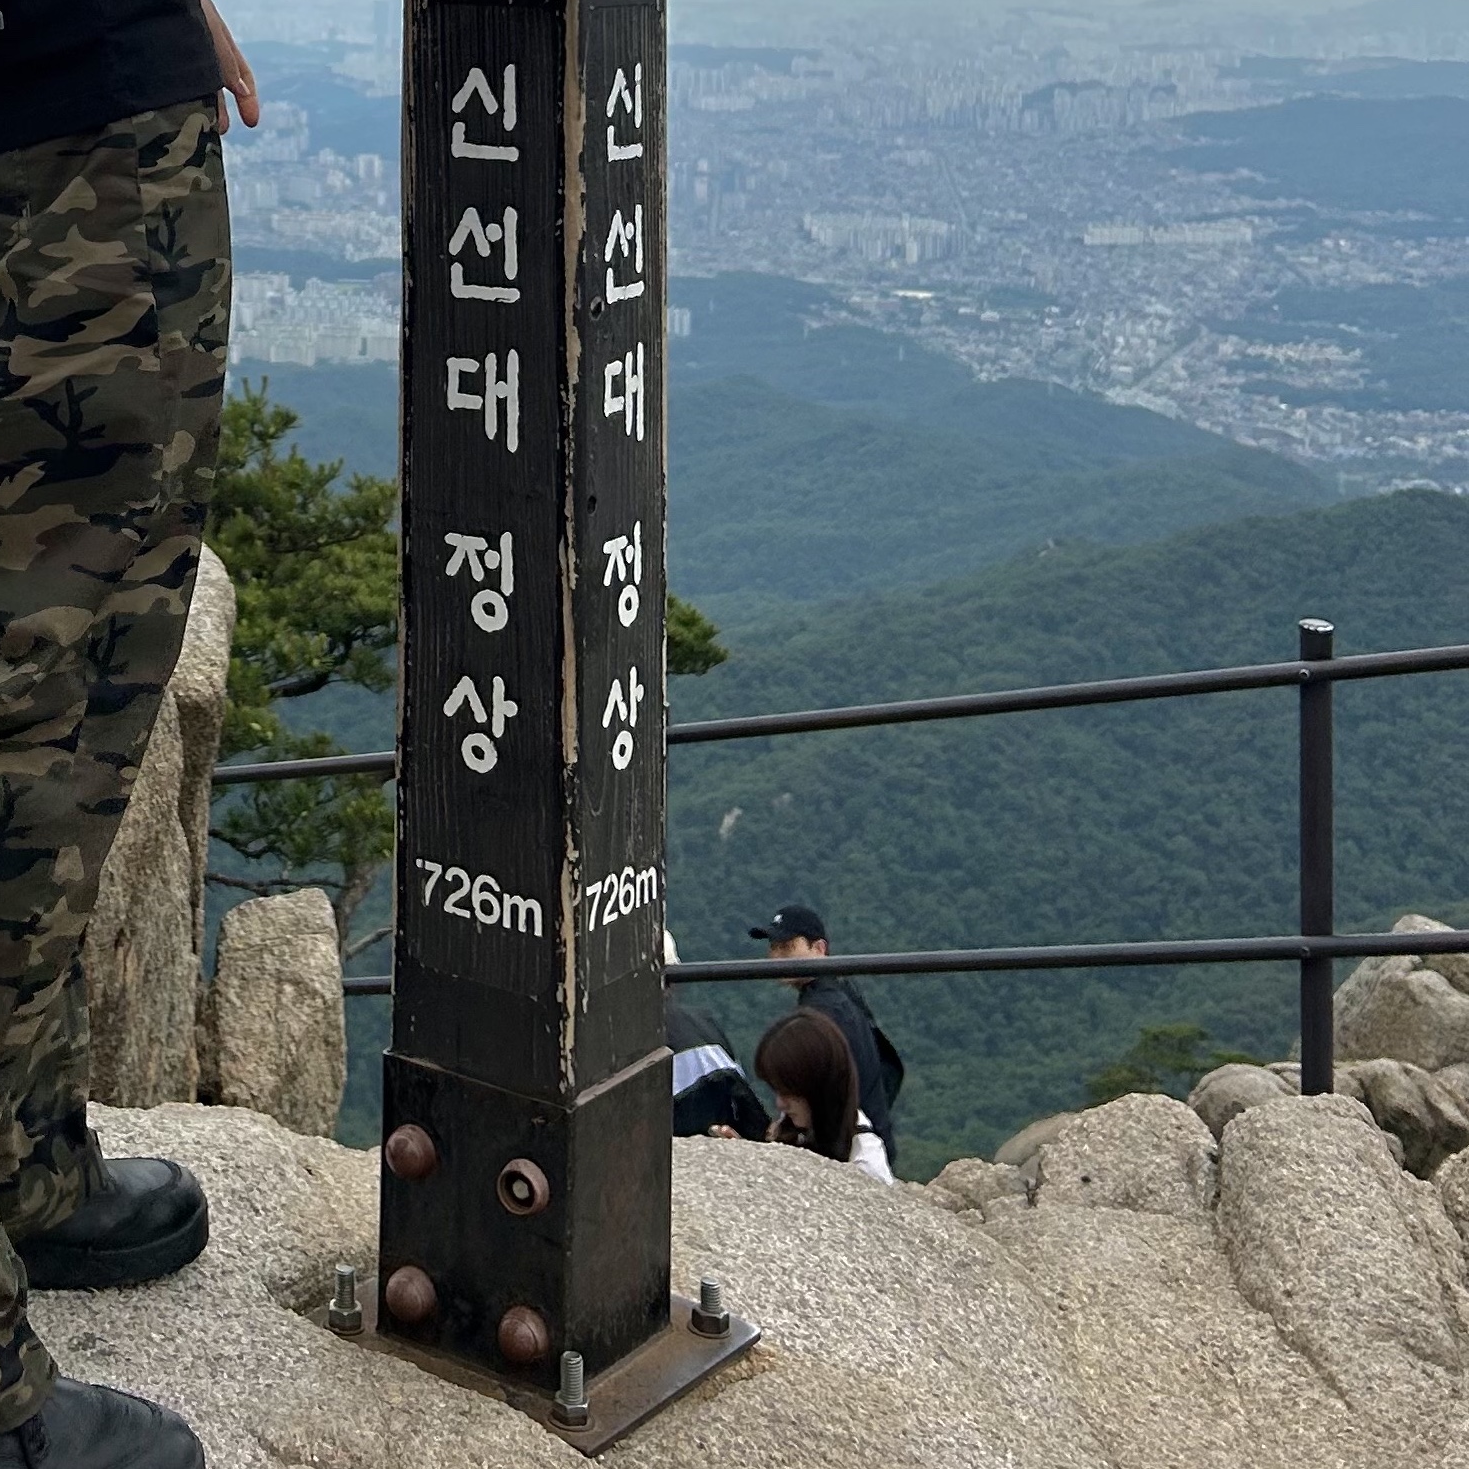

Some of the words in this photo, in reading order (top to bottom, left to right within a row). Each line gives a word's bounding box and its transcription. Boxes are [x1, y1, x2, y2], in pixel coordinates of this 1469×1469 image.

[446, 63, 520, 454] 신선대
[604, 63, 645, 442] 신선대
[443, 531, 518, 774] 정상
[602, 520, 645, 771] 정상
[415, 858, 544, 938] 726m
[586, 865, 658, 932] 726m
